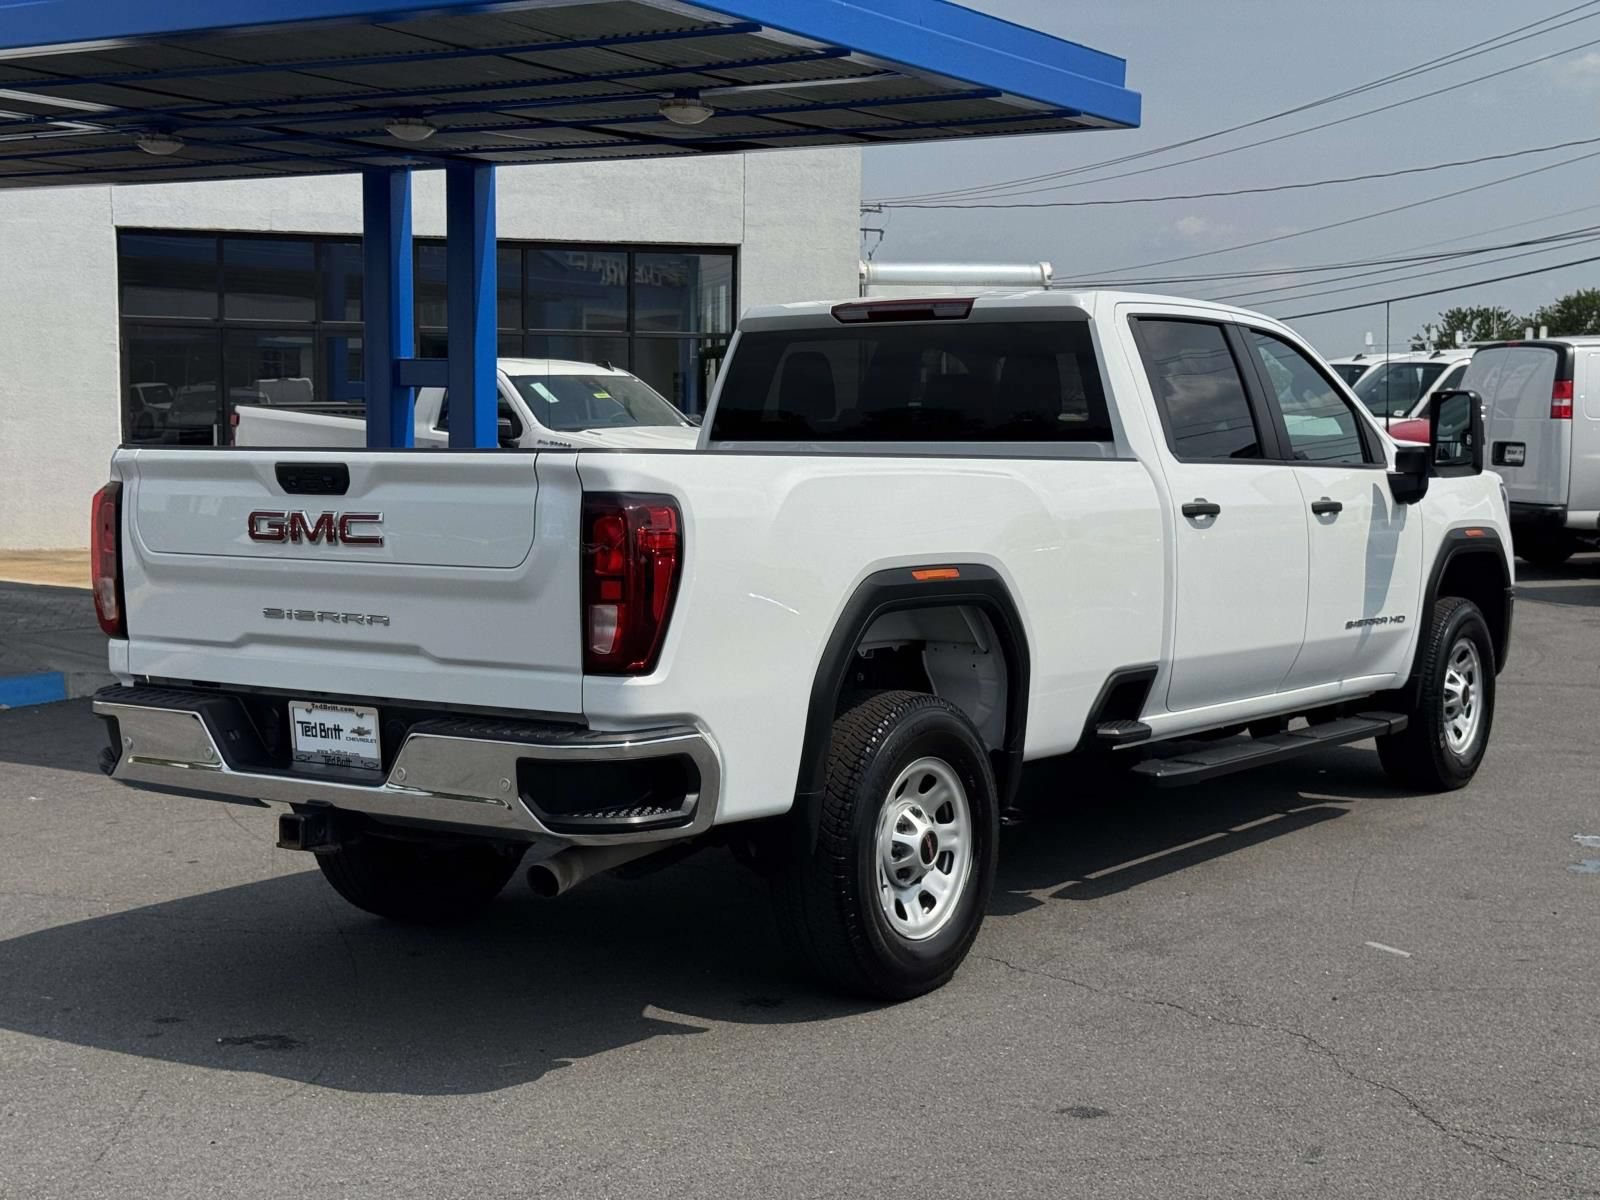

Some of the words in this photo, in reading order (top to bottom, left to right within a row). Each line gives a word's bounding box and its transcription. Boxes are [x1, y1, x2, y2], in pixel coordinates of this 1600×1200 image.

[248, 509, 385, 548] GMC
[263, 607, 391, 627] SIERRA
[1345, 616, 1388, 630] SIERRA
[1389, 615, 1406, 625] HD
[296, 720, 318, 738] Ted
[319, 722, 344, 741] Britt
